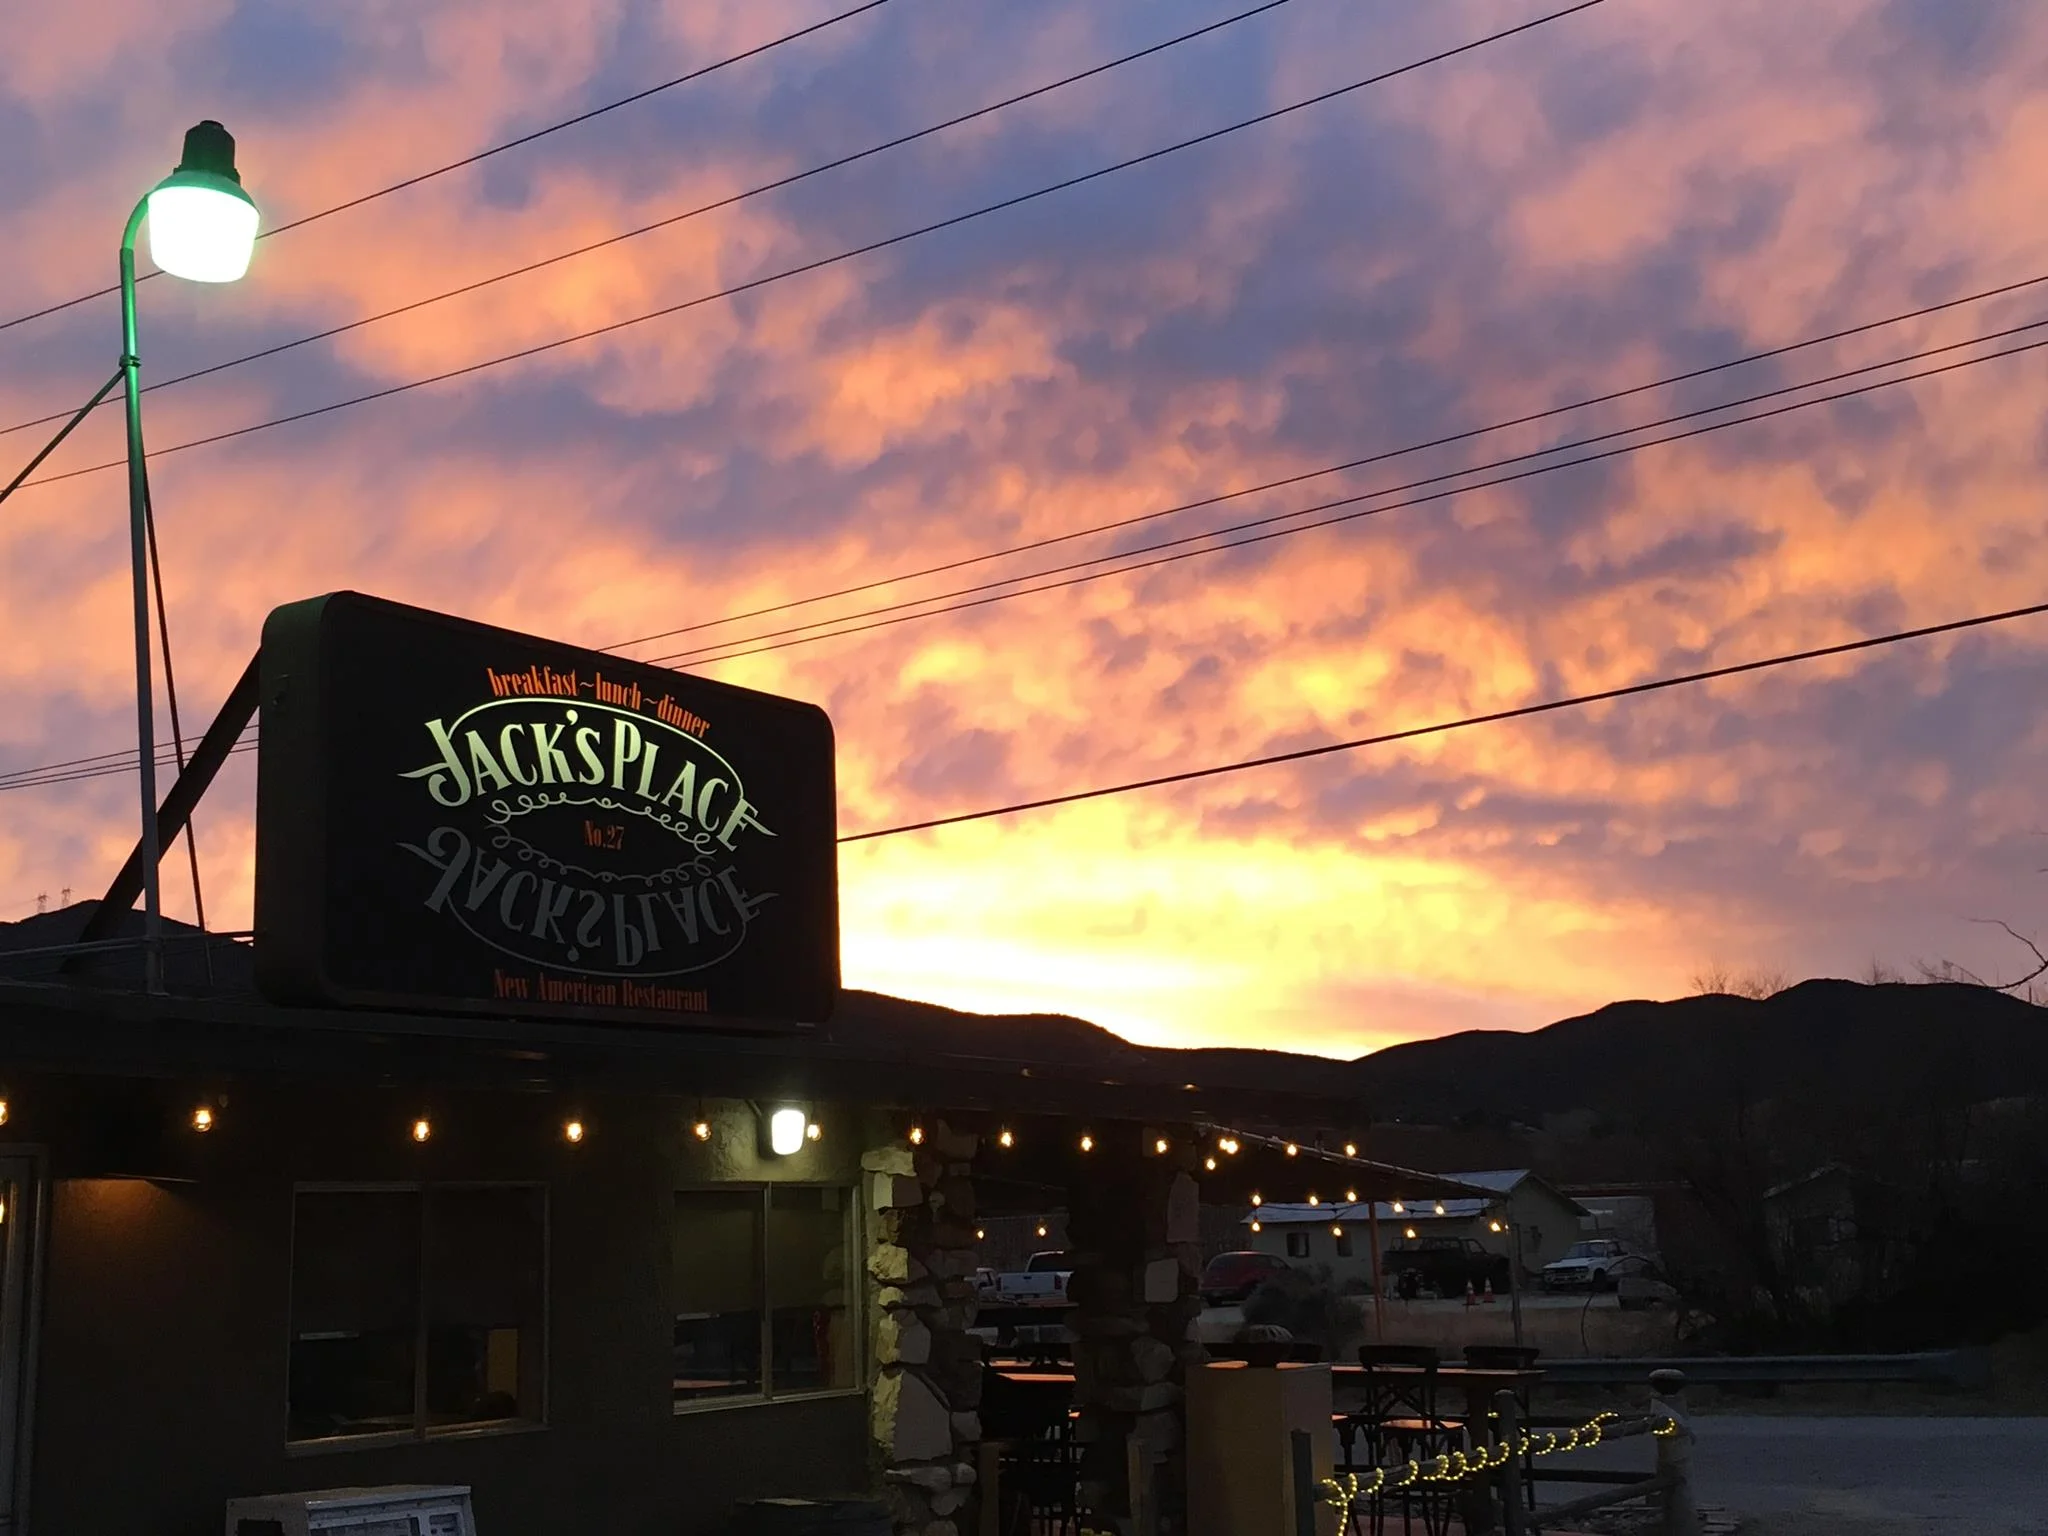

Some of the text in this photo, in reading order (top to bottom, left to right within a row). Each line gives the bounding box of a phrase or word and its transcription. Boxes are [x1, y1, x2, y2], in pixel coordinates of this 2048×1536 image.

[397, 708, 779, 852] JACK'S PLACE
[494, 968, 709, 1012] New American Restaurant
